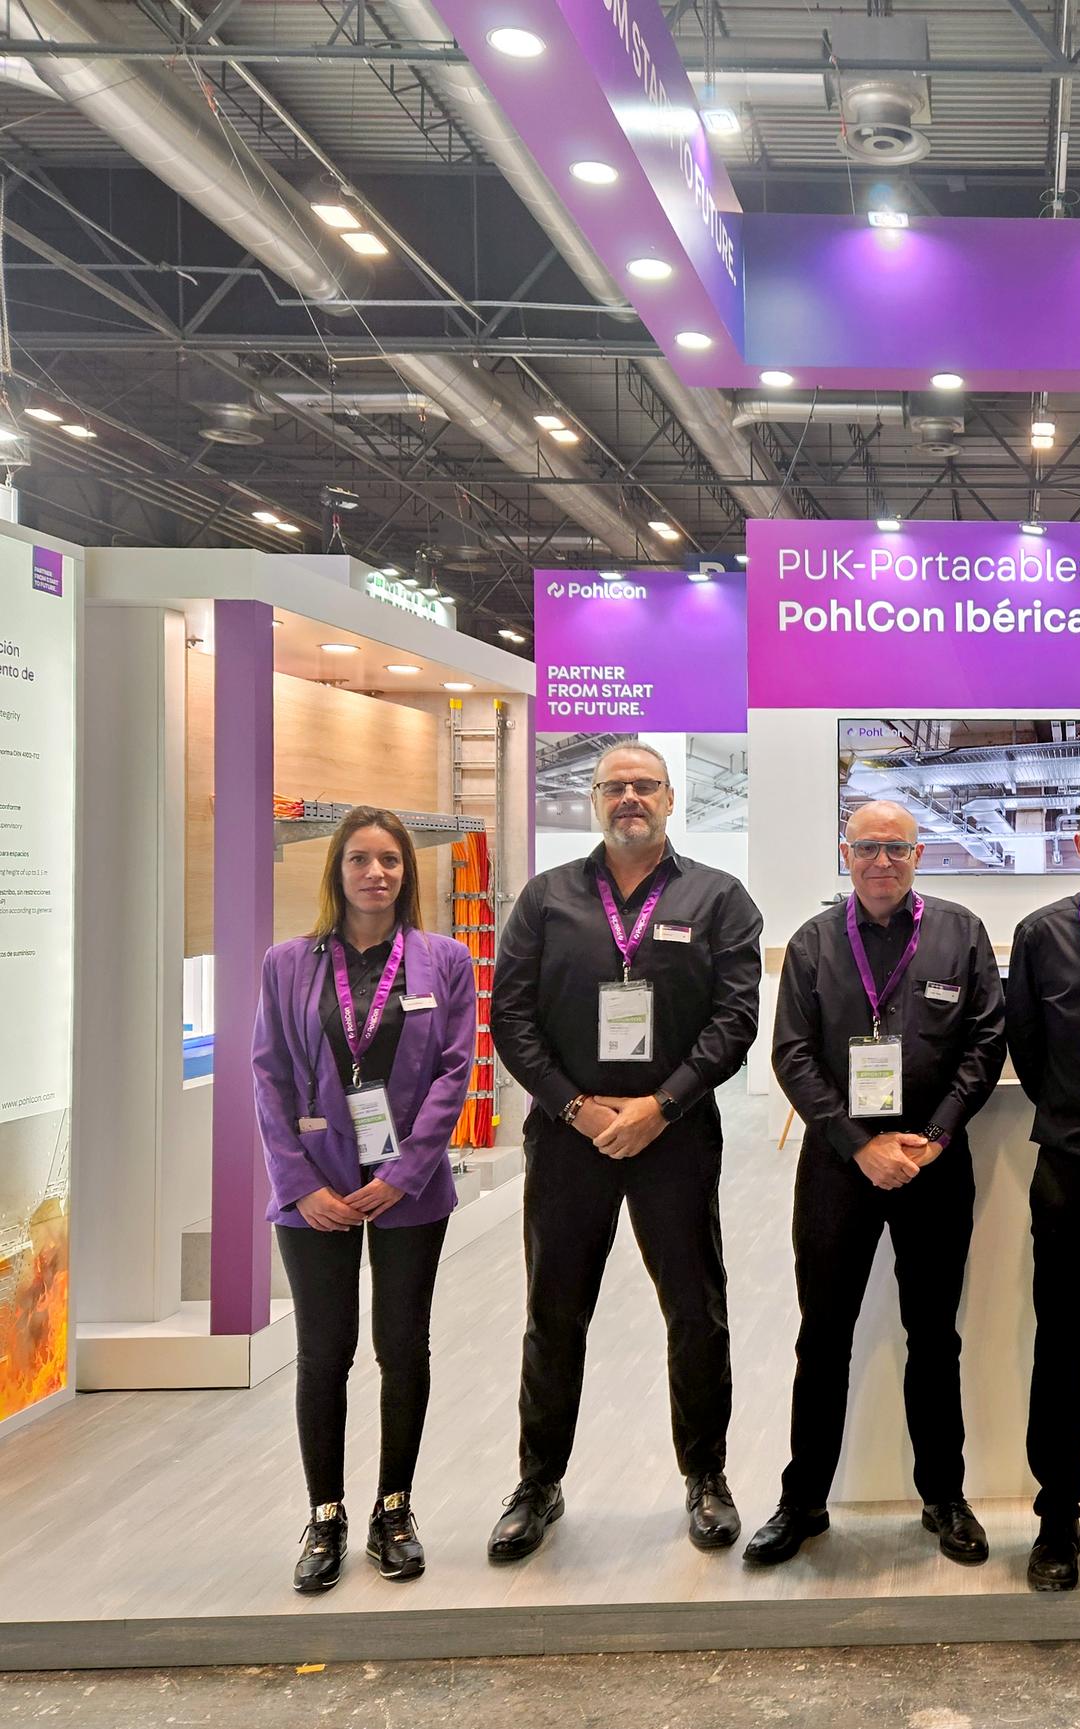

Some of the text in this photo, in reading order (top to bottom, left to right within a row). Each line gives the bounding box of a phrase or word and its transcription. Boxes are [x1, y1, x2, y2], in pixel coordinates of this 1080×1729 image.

[694, 161, 737, 287] FUTURE.
[568, 582, 647, 600] PohlCon
[779, 599, 945, 634] PohlCon
[22, 667, 35, 682] de
[547, 665, 625, 680] PARTNER
[548, 683, 654, 698] FROM START
[547, 701, 645, 716] TO FUTURE.
